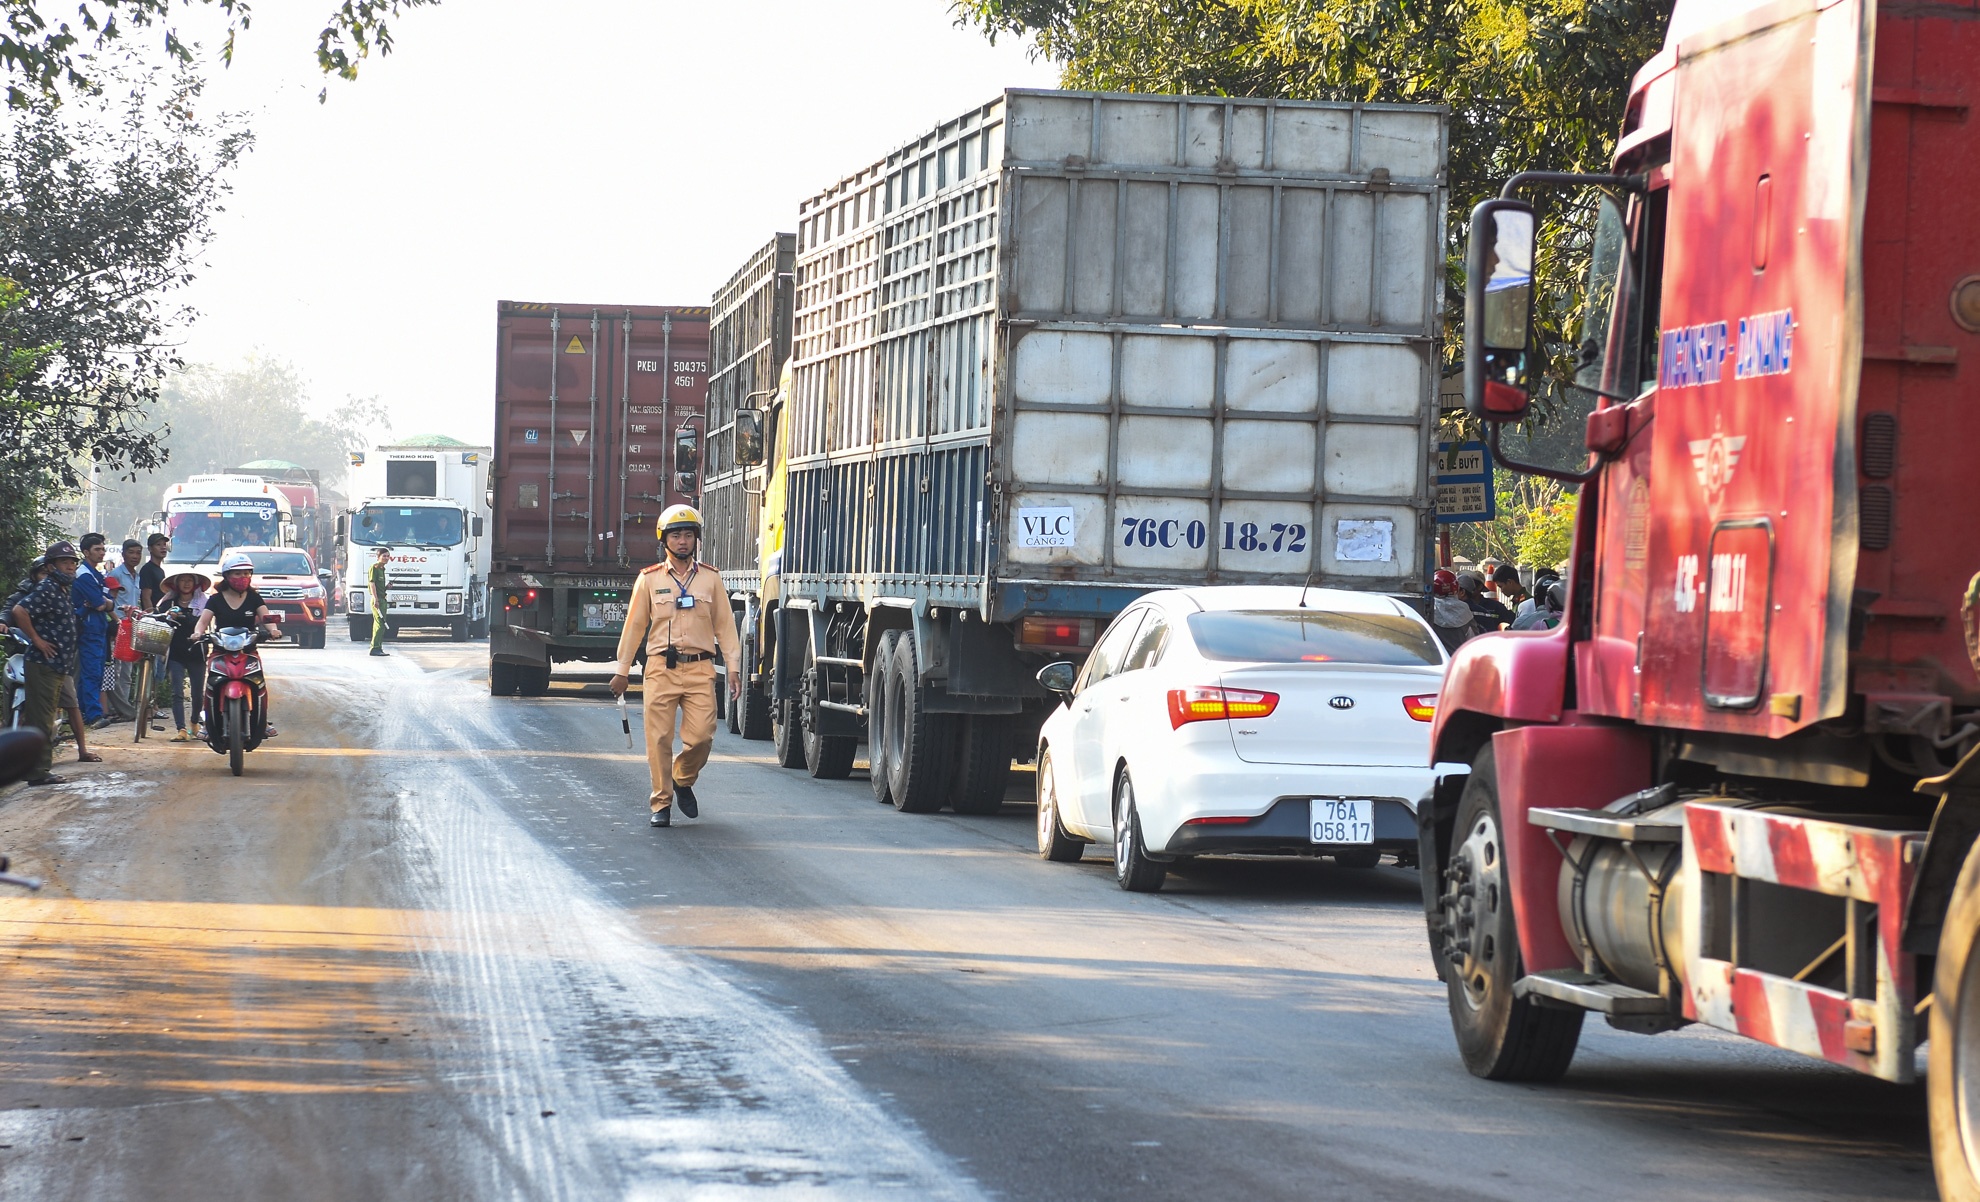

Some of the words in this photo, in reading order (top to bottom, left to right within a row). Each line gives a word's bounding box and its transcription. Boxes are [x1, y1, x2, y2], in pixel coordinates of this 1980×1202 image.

[637, 360, 657, 372] PKEU
[674, 361, 707, 373] 504375
[674, 376, 694, 387] 45G1
[631, 424, 647, 433] TARE
[525, 429, 538, 440] GL
[629, 445, 642, 453] NET
[1459, 455, 1479, 469] BUÝT
[262, 509, 270, 519] 5
[1022, 515, 1070, 536] VLC
[1025, 535, 1057, 546] CẢNG
[1059, 537, 1065, 545] 2
[1120, 517, 1206, 549] 76C-0
[1221, 520, 1307, 553] 18.72
[609, 603, 624, 612] 43R
[1332, 697, 1352, 707] KIA
[1325, 802, 1358, 821] 76A
[1313, 822, 1371, 842] 058.17
